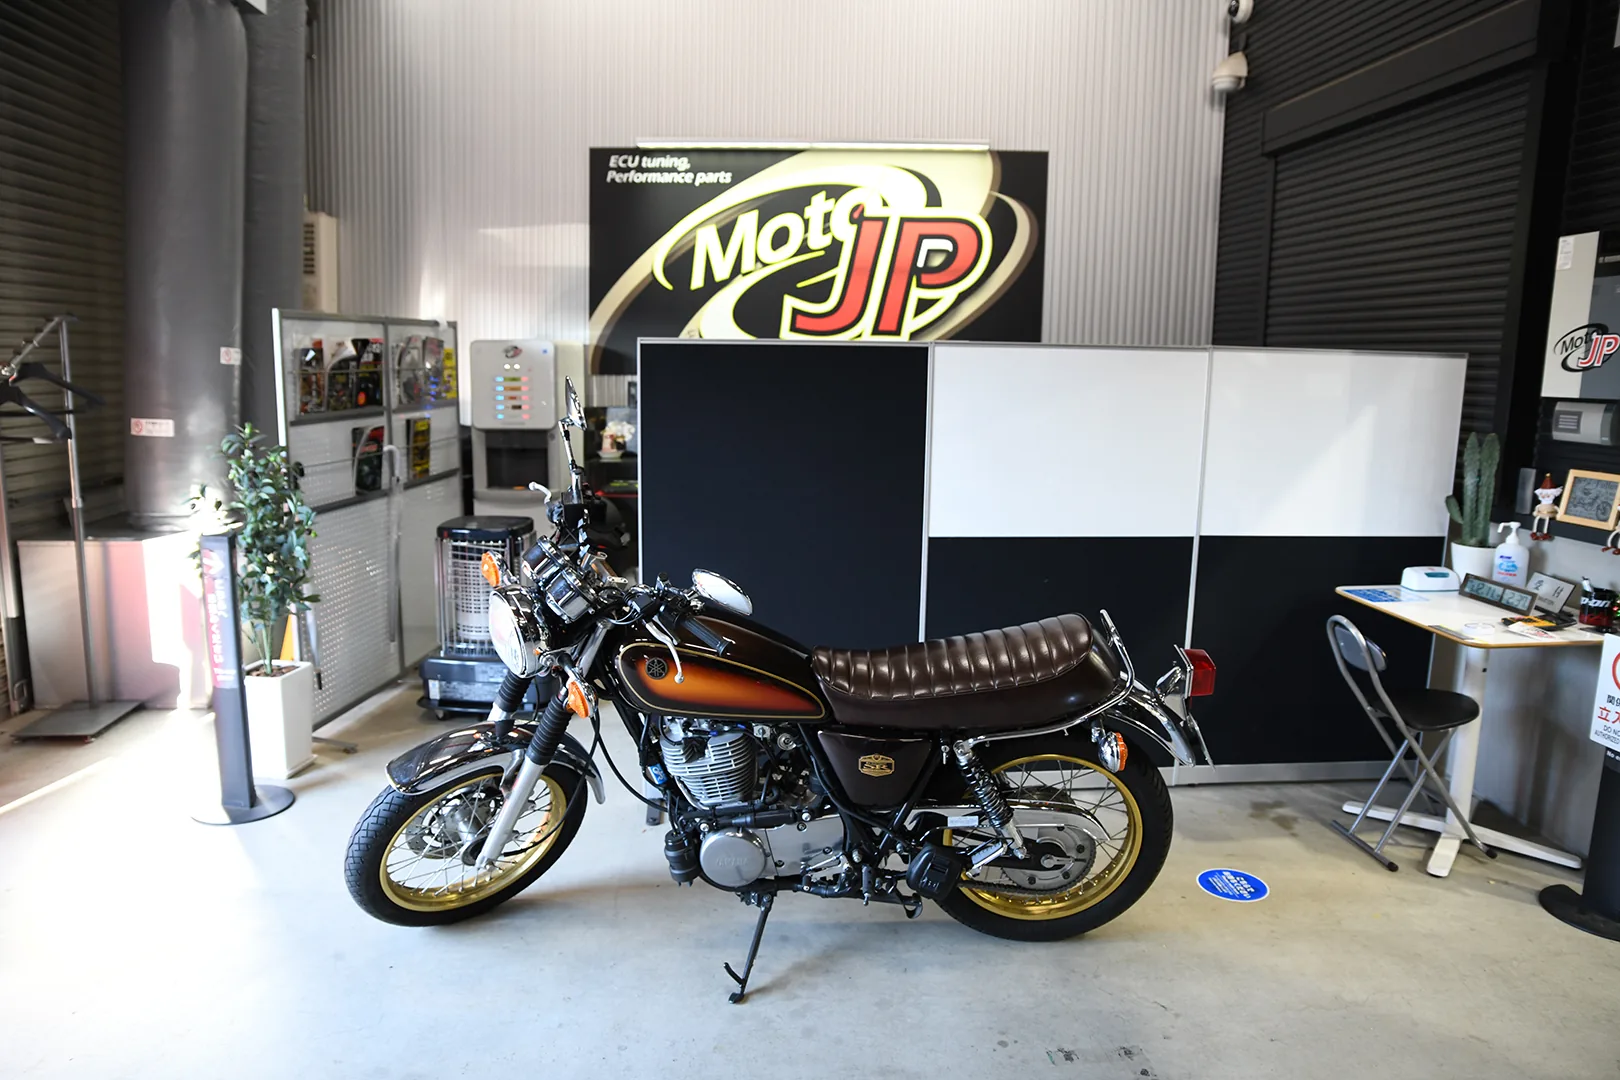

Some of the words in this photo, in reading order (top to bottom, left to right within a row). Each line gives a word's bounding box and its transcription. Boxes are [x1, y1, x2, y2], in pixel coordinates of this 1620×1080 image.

[608, 155, 640, 168] ECU
[641, 155, 690, 171] tuning,
[606, 170, 694, 183] Performance
[694, 171, 733, 187] parts
[785, 211, 989, 338] JP
[1577, 334, 1620, 367] JP
[1603, 725, 1612, 733] DO
